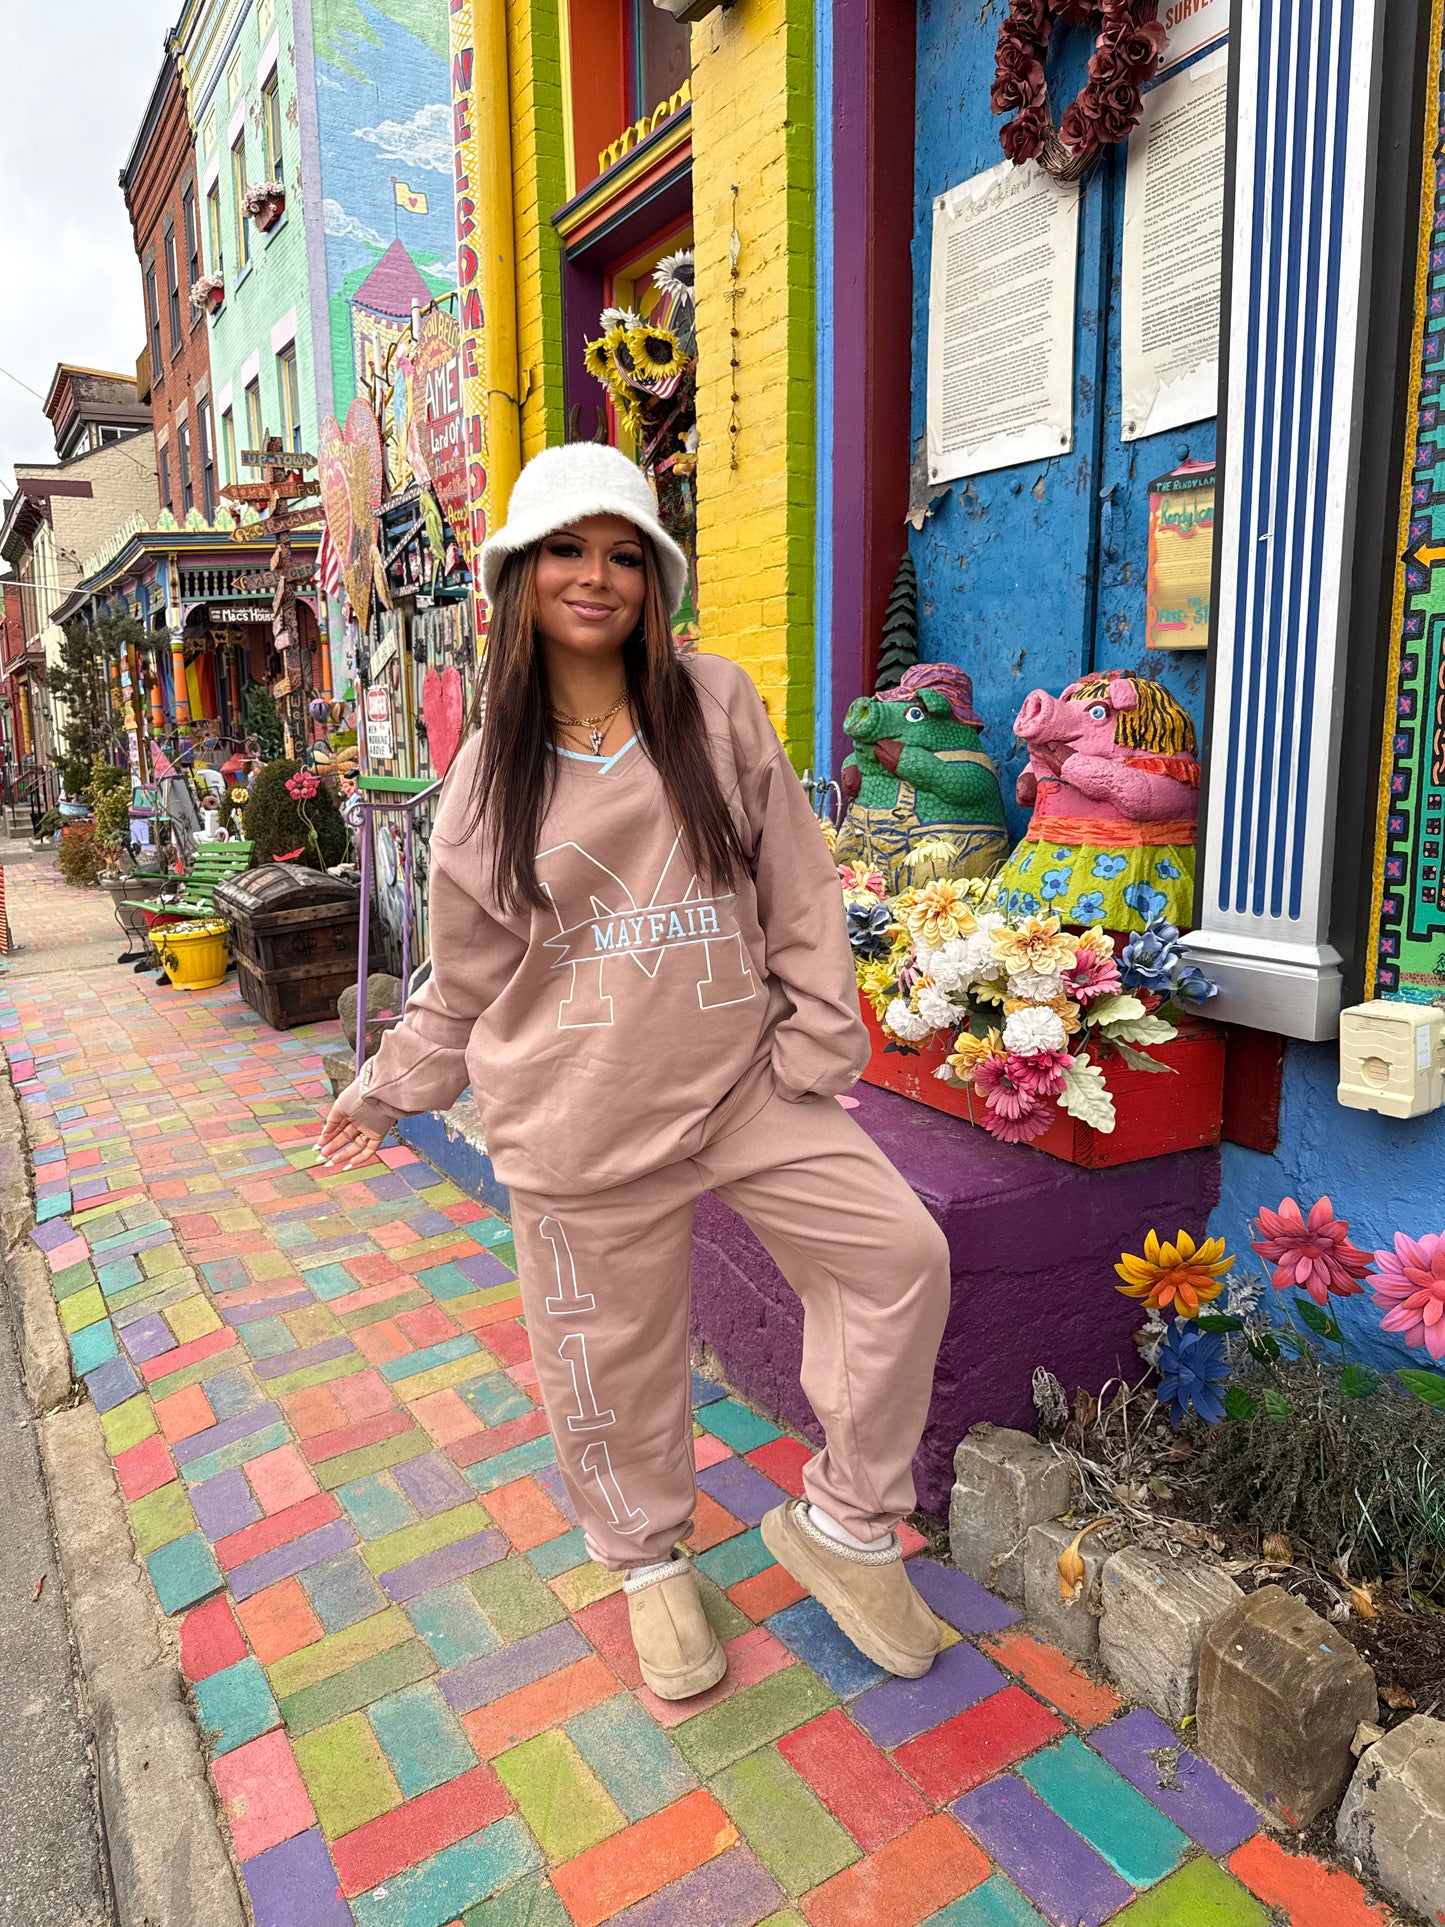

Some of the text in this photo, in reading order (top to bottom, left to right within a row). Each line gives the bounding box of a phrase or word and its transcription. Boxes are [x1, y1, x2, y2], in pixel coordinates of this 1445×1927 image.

[1165, 0, 1213, 30] SURV
[424, 354, 463, 423] AME
[590, 904, 722, 952] MAYFAIR
